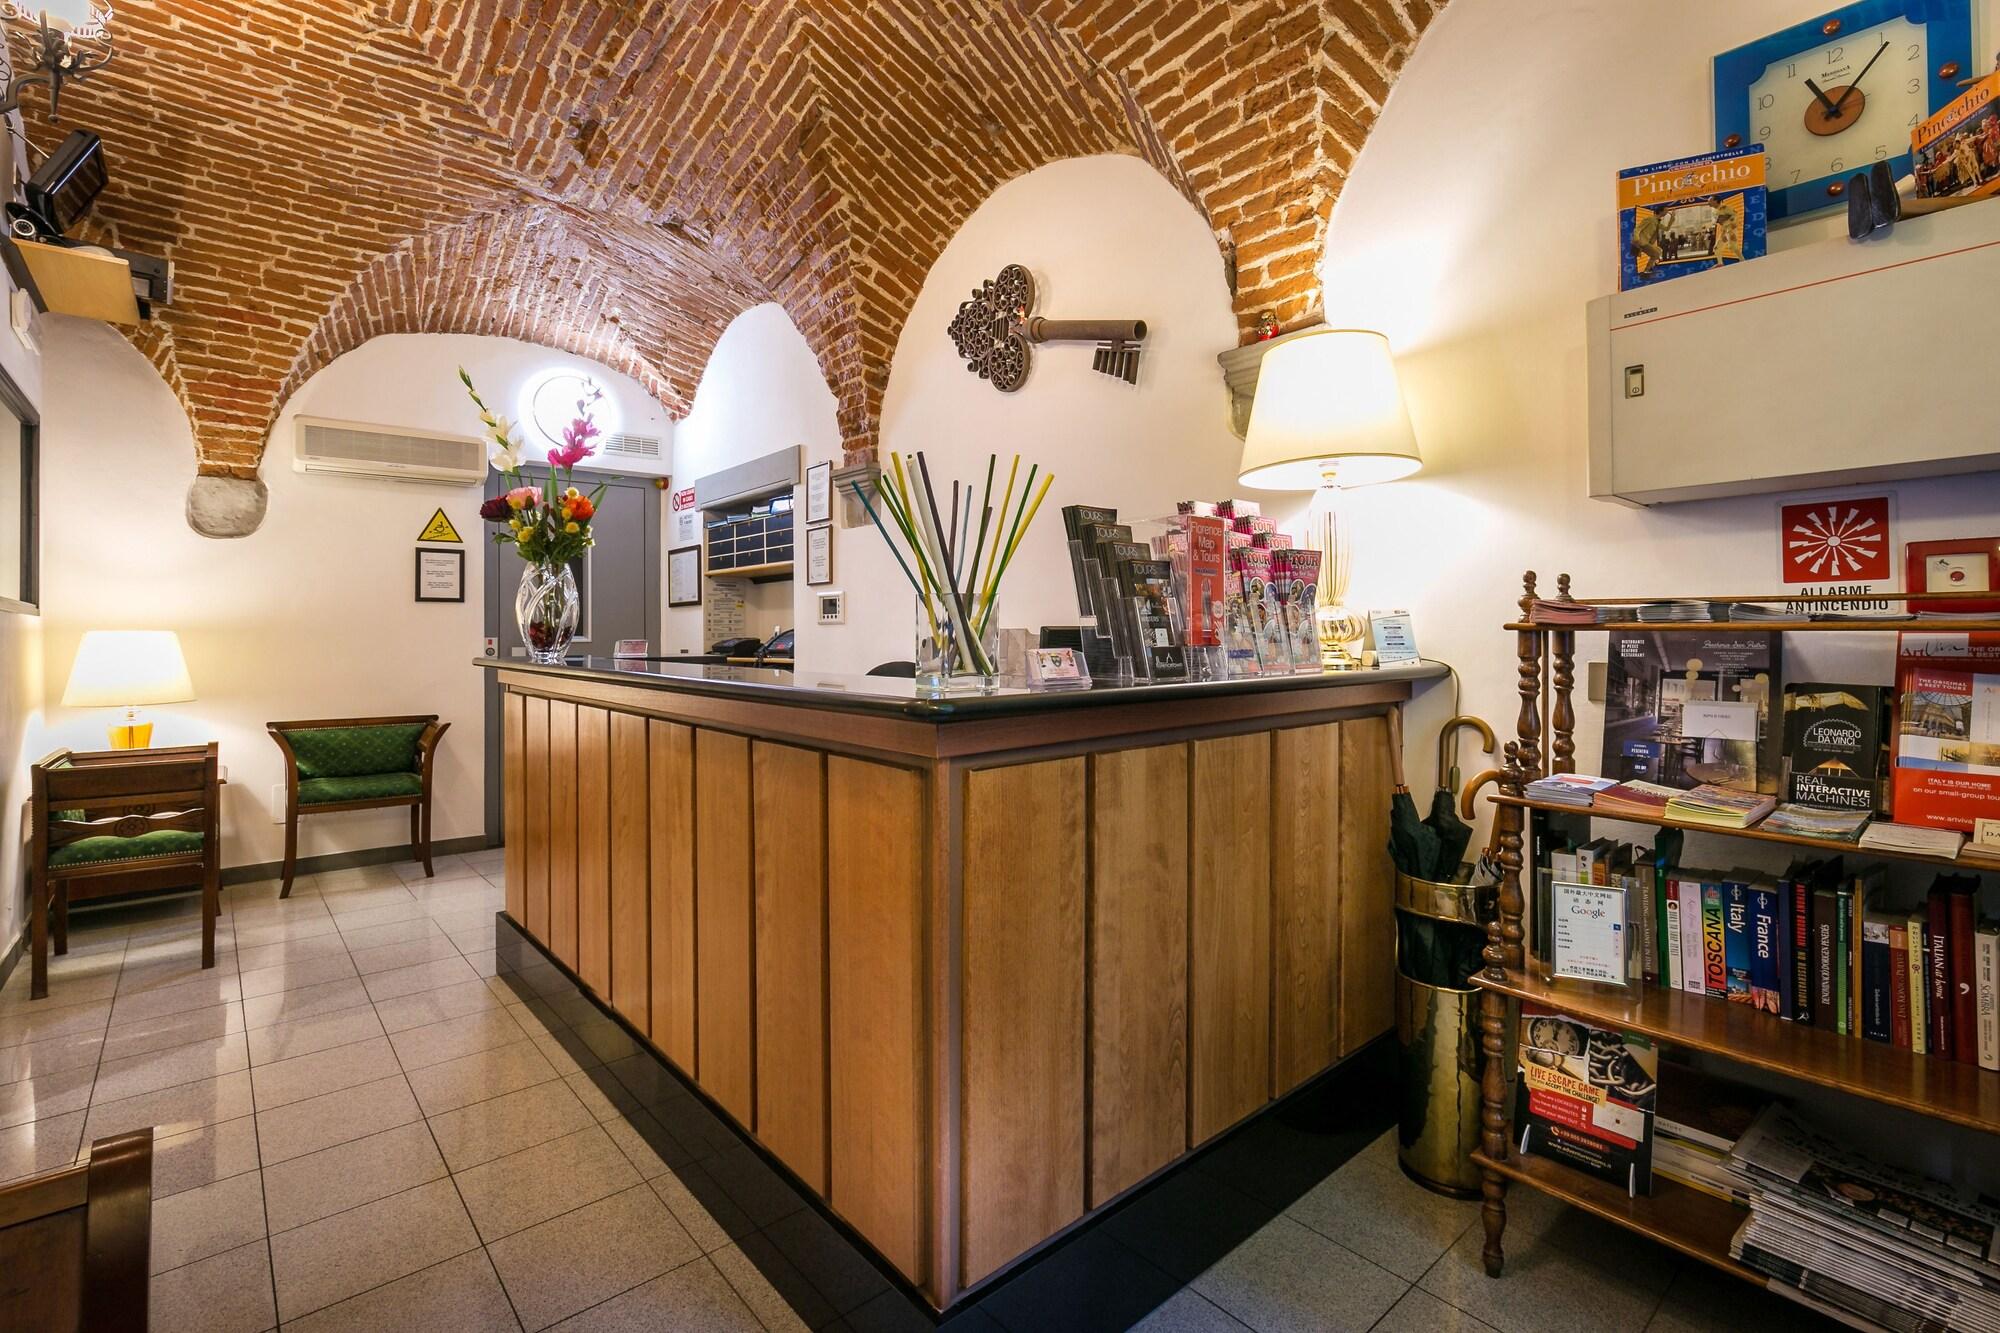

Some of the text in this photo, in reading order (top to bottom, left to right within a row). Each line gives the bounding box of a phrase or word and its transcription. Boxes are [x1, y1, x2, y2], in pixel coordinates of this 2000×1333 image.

[1827, 47, 1844, 64] 12
[1907, 44, 1920, 61] 2
[1787, 64, 1796, 78] 11
[1907, 78, 1920, 94] 3
[1758, 94, 1774, 110] 10
[1908, 113, 1920, 126] 4
[1760, 126, 1771, 140] 9
[1874, 144, 1888, 160] 5
[1830, 158, 1844, 172] 6
[1790, 170, 1800, 184] 7
[1080, 509, 1103, 521] TOURS
[1095, 527, 1120, 538] TOURS
[1191, 522, 1222, 537] Florence
[1114, 544, 1137, 556] TOURS
[1198, 536, 1215, 550] Map
[1193, 551, 1220, 564] & Tours
[1247, 552, 1271, 565] TOUR
[1291, 554, 1319, 566] TOUR
[1133, 563, 1157, 574] TOURS
[1800, 585, 1872, 596] ALLARME
[1786, 600, 1888, 612] ANTINCENDIO
[1813, 728, 1861, 738] LEONARDO
[1832, 737, 1855, 745] VINCI
[1797, 775, 1827, 785] REAL
[1796, 783, 1870, 798] INTERACTIVE
[1939, 789, 1984, 800] small-group
[1796, 791, 1870, 807] MACHINES!
[1571, 905, 1606, 919] Google
[1728, 903, 1746, 933] Italy
[1757, 914, 1772, 958] France
[1706, 908, 1723, 984] TOSCANA
[1934, 935, 1946, 999] ITALIAN at home
[1530, 1066, 1600, 1097] LIVE ESCAPE GAME
[1545, 1082, 1561, 1091] ACCEPT
[1572, 1090, 1600, 1103] CHALLENGE?
